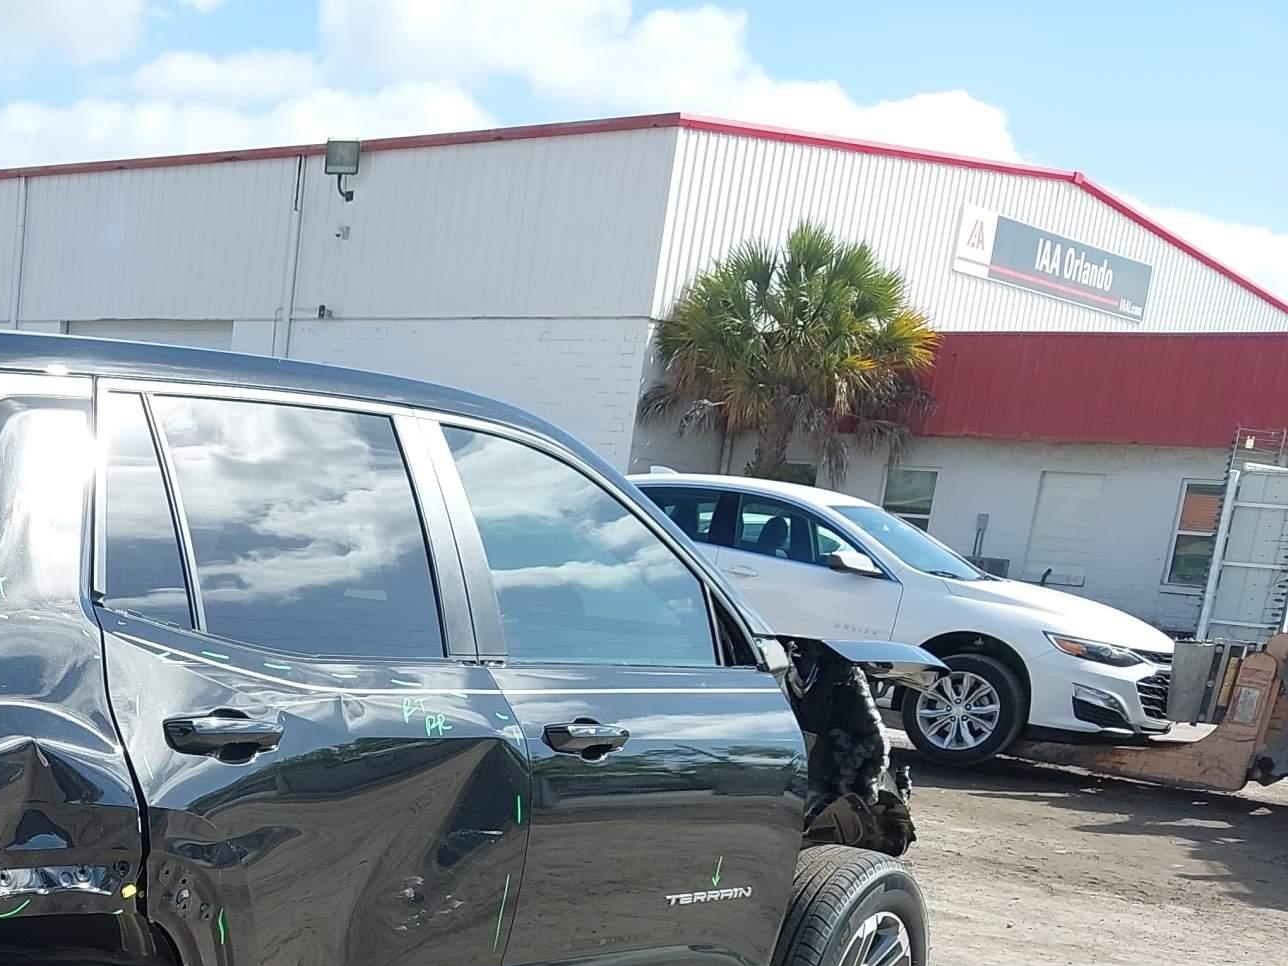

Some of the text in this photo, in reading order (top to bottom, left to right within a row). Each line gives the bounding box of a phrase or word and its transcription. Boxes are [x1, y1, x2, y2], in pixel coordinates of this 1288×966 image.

[1034, 237, 1114, 292] IAA Orlando
[665, 886, 752, 906] TERRAIN
